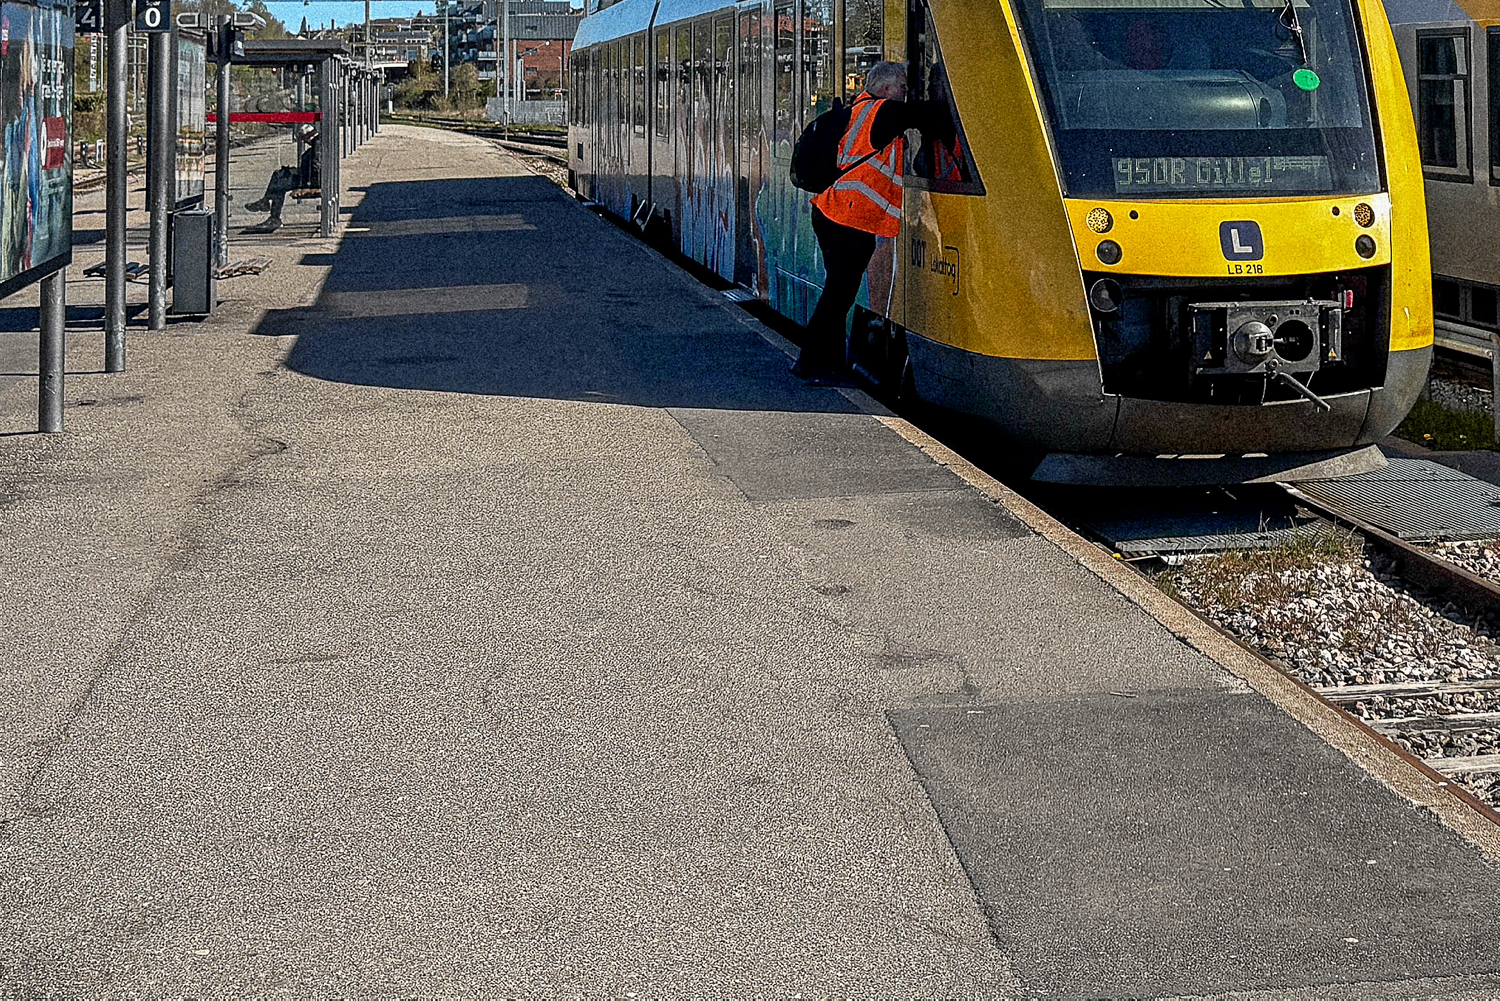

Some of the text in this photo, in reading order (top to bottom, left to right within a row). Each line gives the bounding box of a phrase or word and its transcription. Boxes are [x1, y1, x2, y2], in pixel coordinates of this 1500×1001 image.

[145, 7, 161, 28] 0
[1230, 228, 1253, 253] L
[911, 237, 956, 284] DOT Lokaltog
[1227, 264, 1263, 275] LB 218
